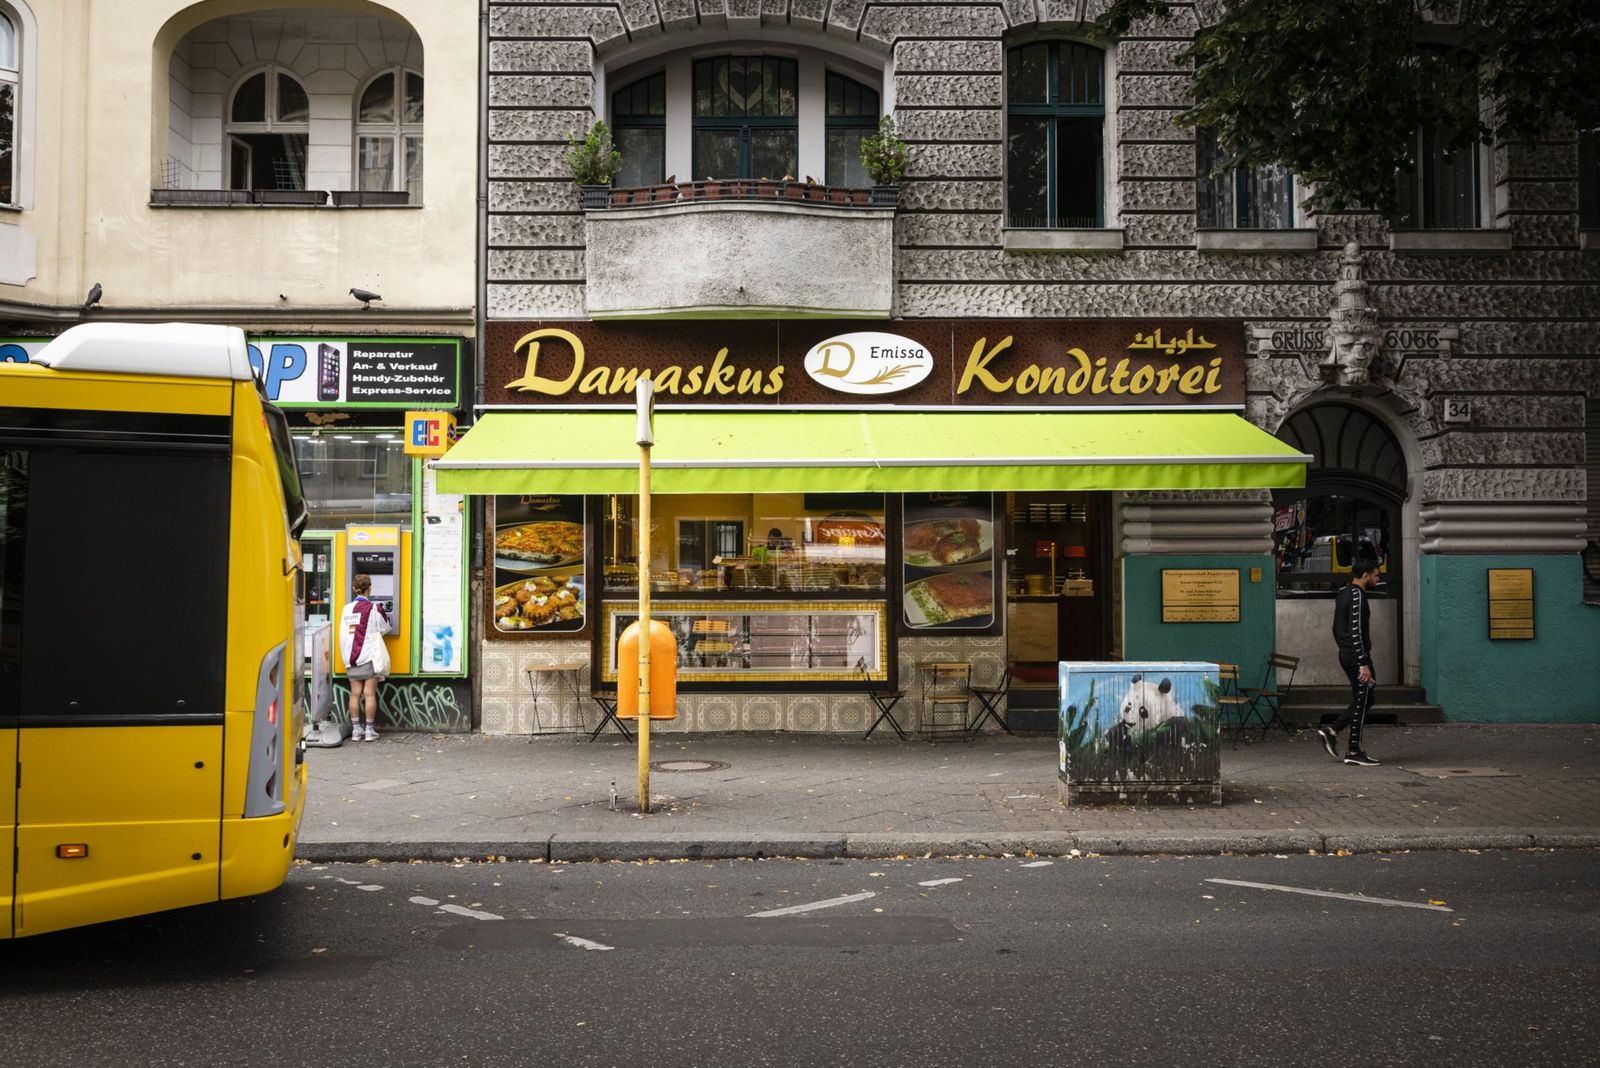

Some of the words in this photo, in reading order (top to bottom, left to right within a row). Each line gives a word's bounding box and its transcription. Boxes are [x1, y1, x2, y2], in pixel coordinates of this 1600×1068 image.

[1126, 327, 1217, 355] حلويات
[1272, 329, 1325, 350] GRÜSS
[353, 350, 414, 360] Reparatur
[870, 346, 924, 359] Emissa
[352, 362, 373, 371] An-
[376, 362, 386, 371] &
[389, 362, 438, 371] Verkauf
[504, 328, 785, 396] Damaskus
[957, 335, 1222, 395] Konditorei
[352, 374, 445, 384] Handy-Zubehör
[352, 386, 452, 396] Express-Service
[1449, 403, 1470, 417] 34
